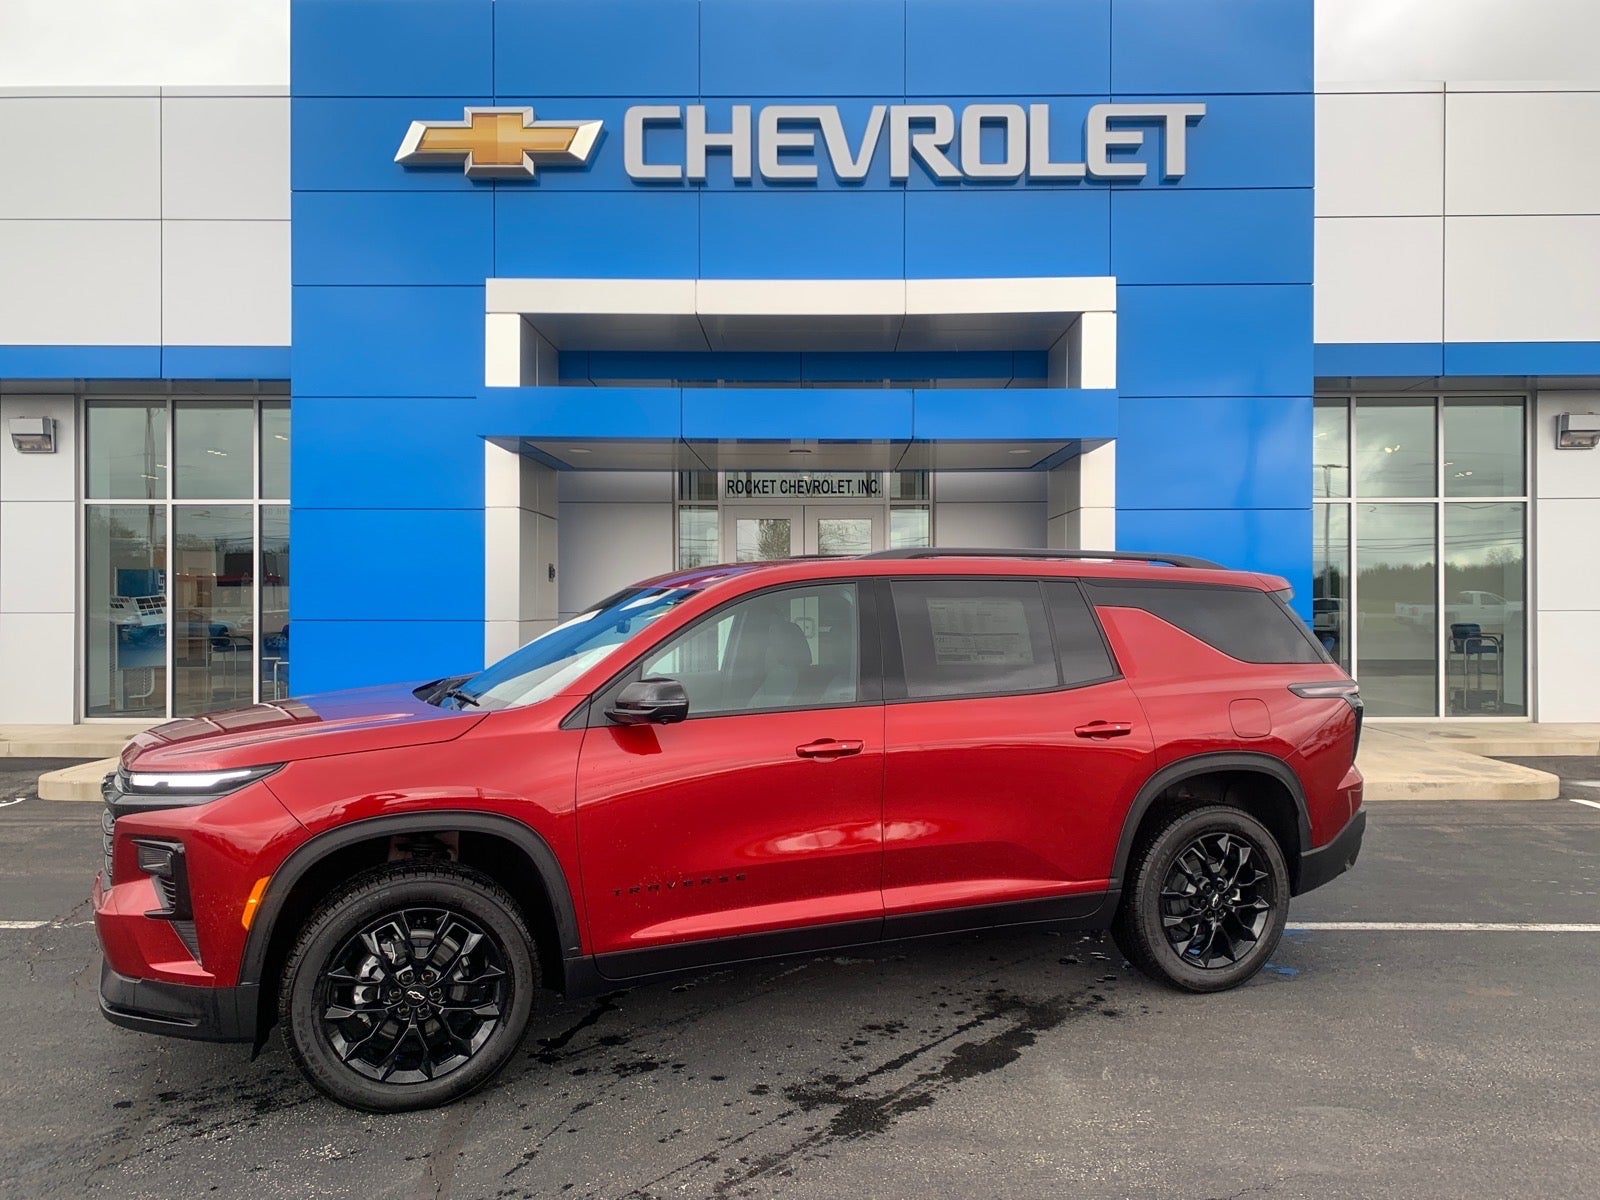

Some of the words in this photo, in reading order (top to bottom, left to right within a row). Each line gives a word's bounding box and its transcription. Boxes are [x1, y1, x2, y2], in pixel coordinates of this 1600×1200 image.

[623, 102, 1206, 184] CHEVROLET
[727, 479, 776, 494] ROCKET
[780, 479, 855, 496] CHEVROLET,
[858, 479, 881, 494] INC.
[612, 873, 747, 897] TRAVERSE
